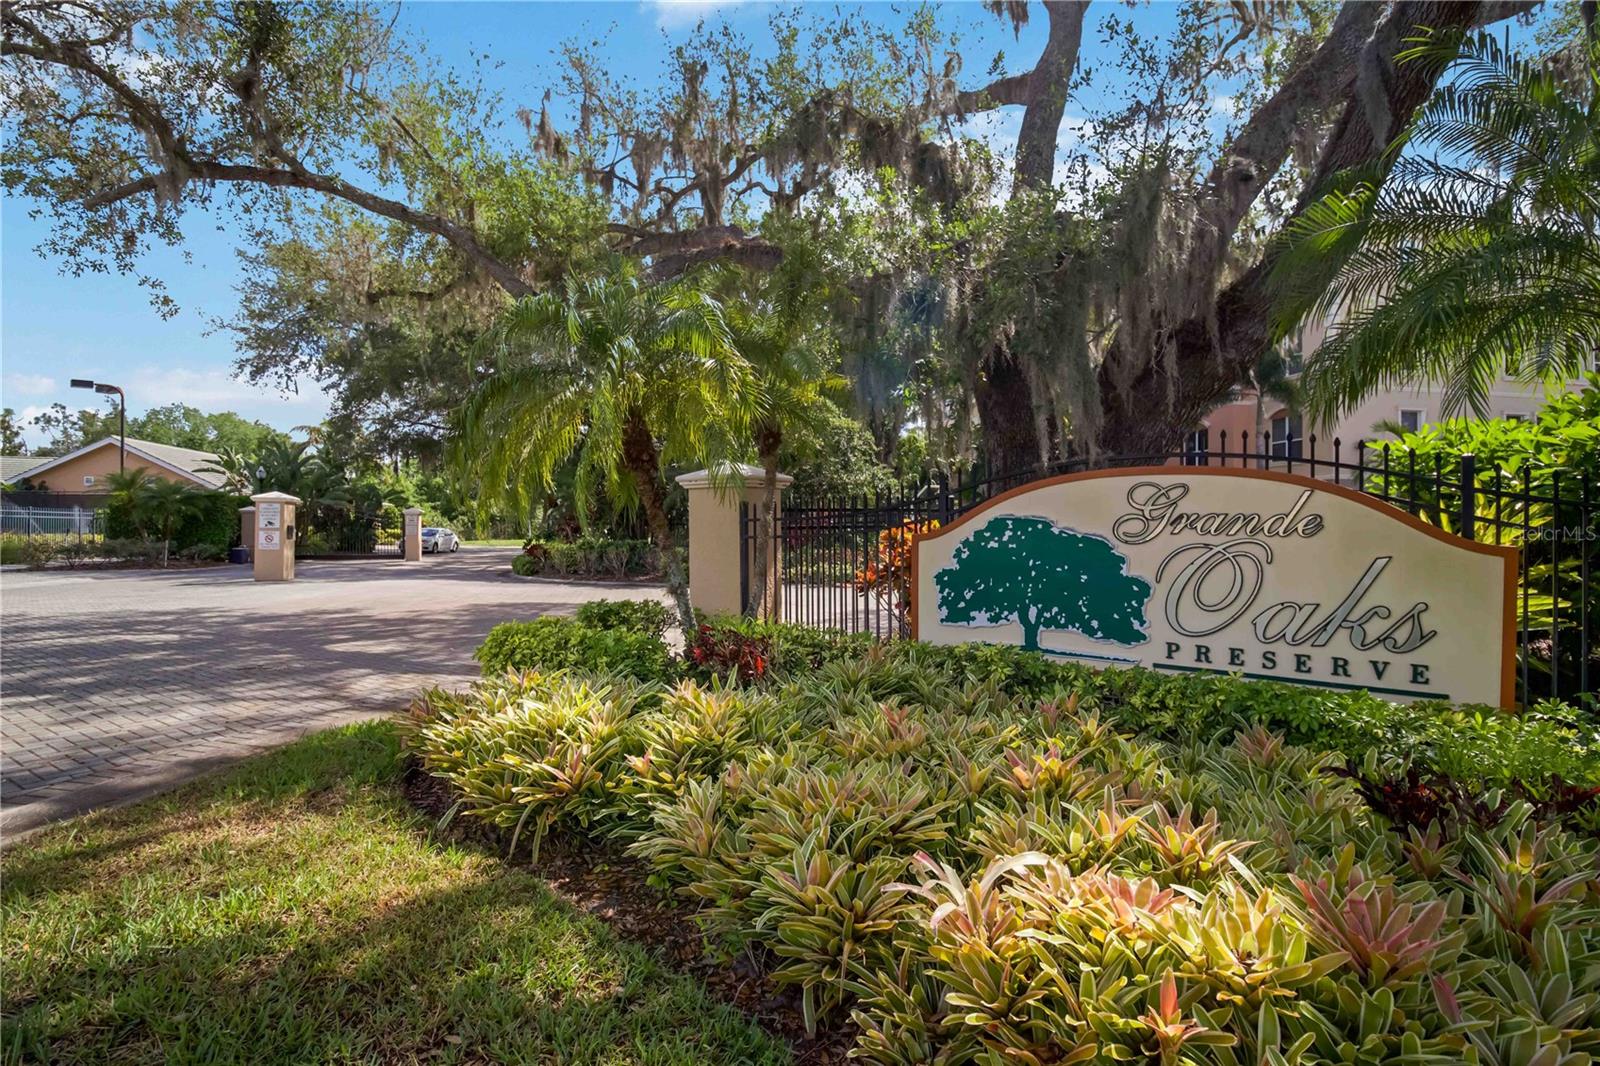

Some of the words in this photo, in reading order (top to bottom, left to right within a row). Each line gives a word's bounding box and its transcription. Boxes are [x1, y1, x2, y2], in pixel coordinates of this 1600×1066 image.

[1112, 482, 1324, 544] Grande
[1155, 538, 1438, 653] Oaks
[1166, 642, 1431, 685] PRESERVE
